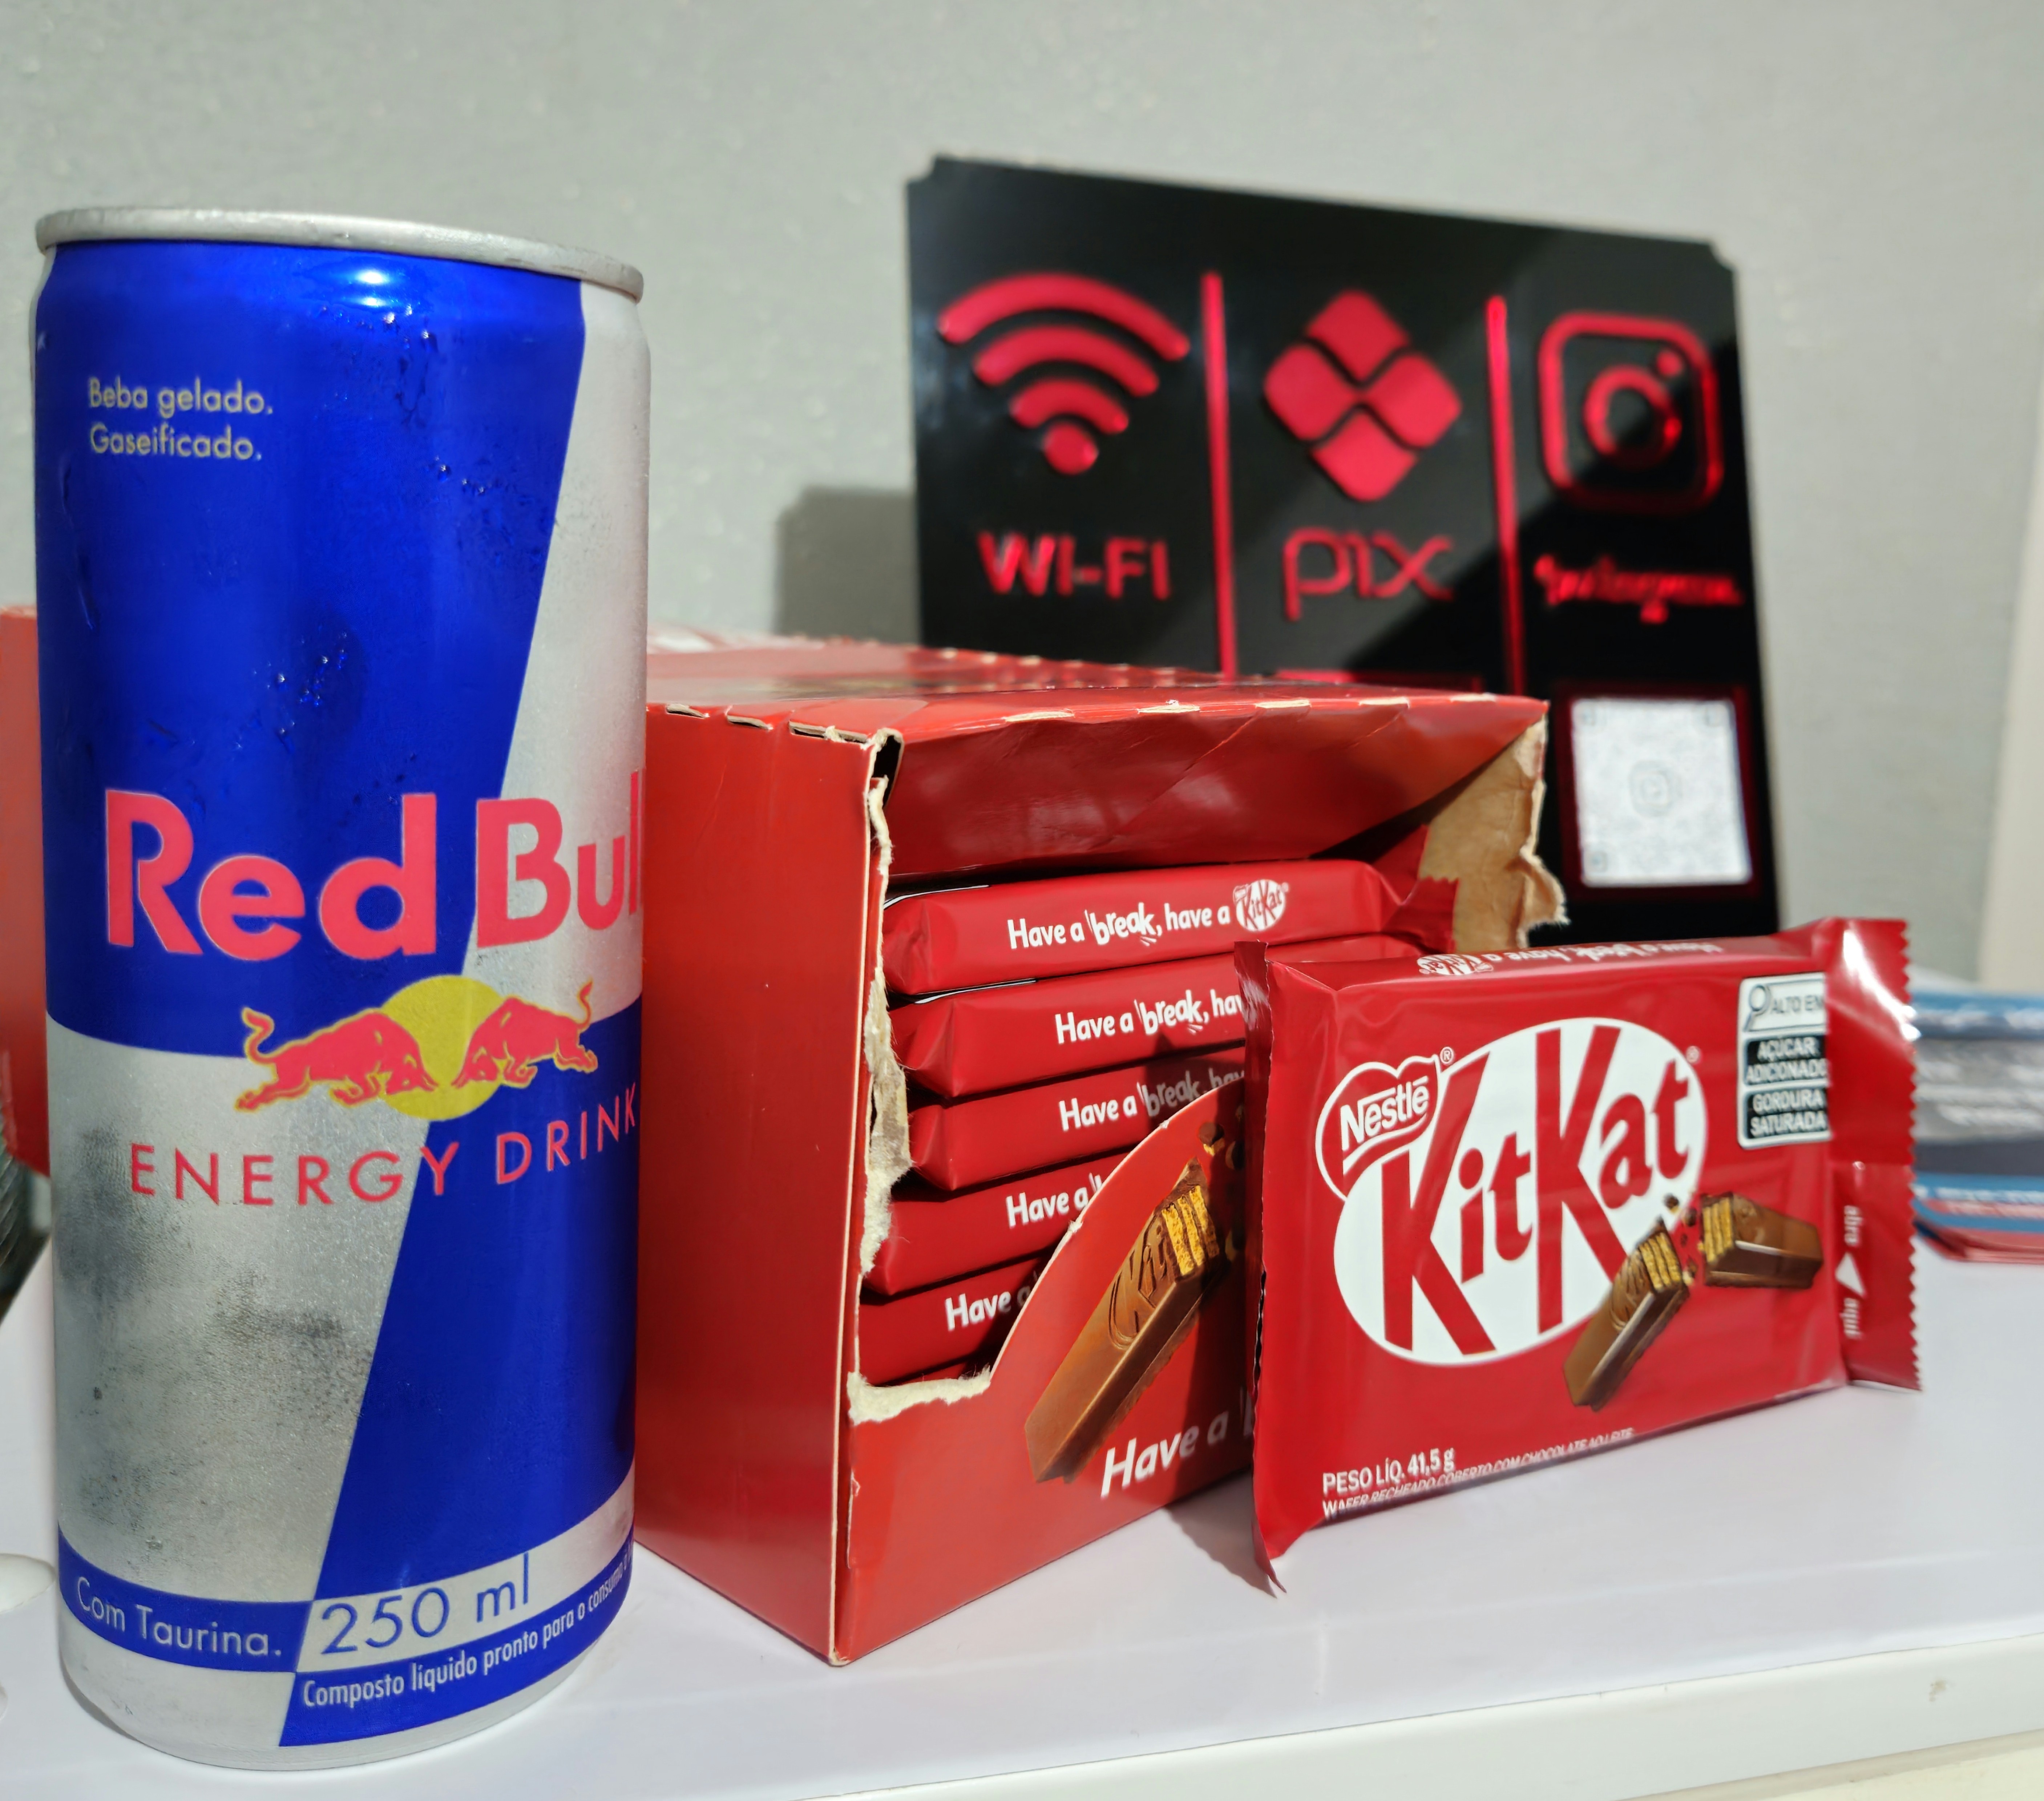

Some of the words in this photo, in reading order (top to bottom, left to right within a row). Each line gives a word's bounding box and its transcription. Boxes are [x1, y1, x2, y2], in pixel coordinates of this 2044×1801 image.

[88, 375, 148, 409] Beba
[157, 376, 273, 419] gelado.
[90, 421, 262, 461] Gaseificado.
[978, 532, 1170, 601] WI-FI
[105, 789, 437, 961] Red
[1007, 918, 1066, 949] Have
[1070, 923, 1085, 942] a
[1164, 902, 1212, 931] have
[1217, 905, 1231, 925] a
[1240, 880, 1282, 930] KitKat
[1055, 1011, 1115, 1044] Have
[1119, 1013, 1134, 1033] a
[1210, 989, 1244, 1017] hav
[1059, 1098, 1119, 1131] Have
[1123, 1095, 1138, 1117] a
[1139, 1070, 1200, 1117] break
[1208, 1067, 1244, 1089] hav
[1340, 1075, 1429, 1151] Nestlé
[1750, 1111, 1827, 1138] SATURADA
[1753, 1089, 1824, 1115] GORDURA
[131, 1141, 460, 1206] ENERGY
[496, 1083, 636, 1185] DRINK
[1006, 1191, 1069, 1228] Have
[1074, 1187, 1088, 1209] a
[1381, 1024, 1689, 1356] KitKat
[945, 1291, 1011, 1332] Have
[1017, 1286, 1031, 1307] a
[1100, 1426, 1199, 1499] Have
[1208, 1411, 1229, 1445] a
[1322, 1467, 1372, 1495] PESO
[1407, 1447, 1441, 1476] 41,5
[1444, 1447, 1455, 1473] g
[77, 1576, 125, 1632] Com
[136, 1604, 281, 1656] Taurina.
[321, 1587, 450, 1655] 250
[477, 1552, 529, 1623] ml
[303, 1675, 404, 1708] Composto
[412, 1649, 477, 1692] líquido
[484, 1629, 538, 1675] pronto
[543, 1611, 574, 1648] para
[578, 1602, 585, 1620] o
